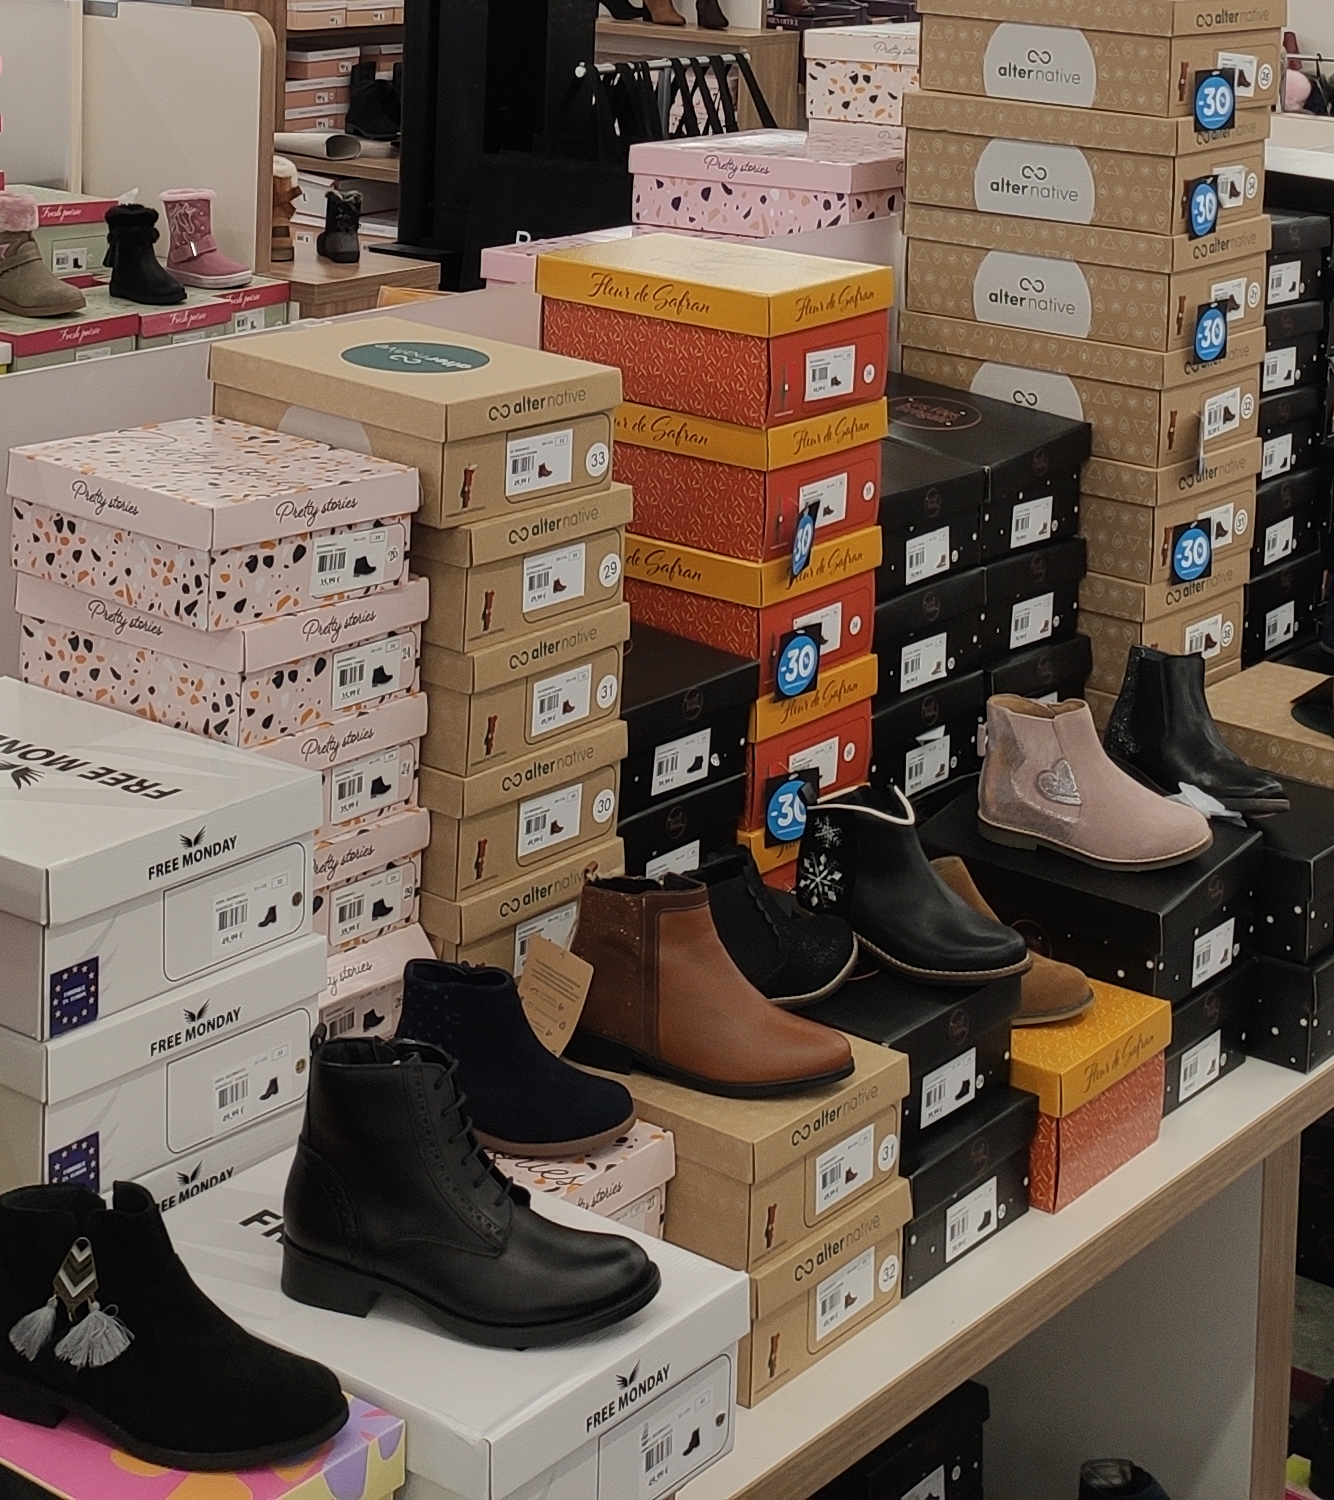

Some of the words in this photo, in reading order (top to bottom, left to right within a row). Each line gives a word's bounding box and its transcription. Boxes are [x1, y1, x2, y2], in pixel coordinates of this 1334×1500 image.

[1215, 7, 1270, 25] alternative
[997, 61, 1081, 86] alternative
[703, 154, 739, 178] Pretty
[740, 161, 771, 176] stories
[989, 175, 1078, 204] alternative
[1209, 229, 1257, 255] alternative
[587, 272, 631, 302] Fleur
[634, 283, 650, 301] de
[651, 283, 710, 318] Safran
[795, 298, 824, 323] Fleur
[838, 285, 875, 306] Safran
[988, 288, 1076, 316] alternative
[513, 388, 587, 415] alternative
[648, 415, 709, 448] Safran
[793, 430, 822, 455] Fleur
[834, 416, 871, 439] Safran
[591, 451, 606, 468] 33
[72, 480, 103, 513] Pretty
[102, 496, 140, 518] stories
[275, 499, 319, 527] Pretty
[321, 497, 358, 514] stories
[531, 506, 599, 537] alternative
[603, 561, 618, 580] 29
[626, 549, 642, 566] de
[644, 552, 703, 581] Safran
[827, 548, 864, 571] Safran
[87, 599, 121, 638] Pretty
[121, 615, 164, 638] stories
[302, 616, 342, 644] Pretty
[343, 609, 377, 631] stories
[402, 647, 411, 660] 24
[531, 627, 597, 661] alternative
[600, 682, 614, 699] 31
[822, 679, 859, 704] Safran
[300, 732, 340, 763] Pretty
[342, 725, 375, 748] stories
[401, 762, 410, 775] 24
[524, 745, 595, 783] alternative
[80, 767, 183, 801] FREE
[597, 797, 611, 814] 30
[148, 856, 180, 881] FREE
[182, 835, 238, 869] MONDAY
[340, 845, 375, 867] stories
[340, 961, 373, 982] stories
[150, 1032, 182, 1057] FREE
[185, 1006, 242, 1042] MONDAY
[813, 1084, 878, 1132] alternative
[881, 1143, 894, 1161] 31
[178, 1167, 235, 1204] MONDAY
[591, 1180, 623, 1207] stories
[817, 1213, 880, 1266] alternative
[883, 1263, 896, 1282] 32
[585, 1408, 616, 1433] FREE
[618, 1363, 671, 1412] MONDAY
